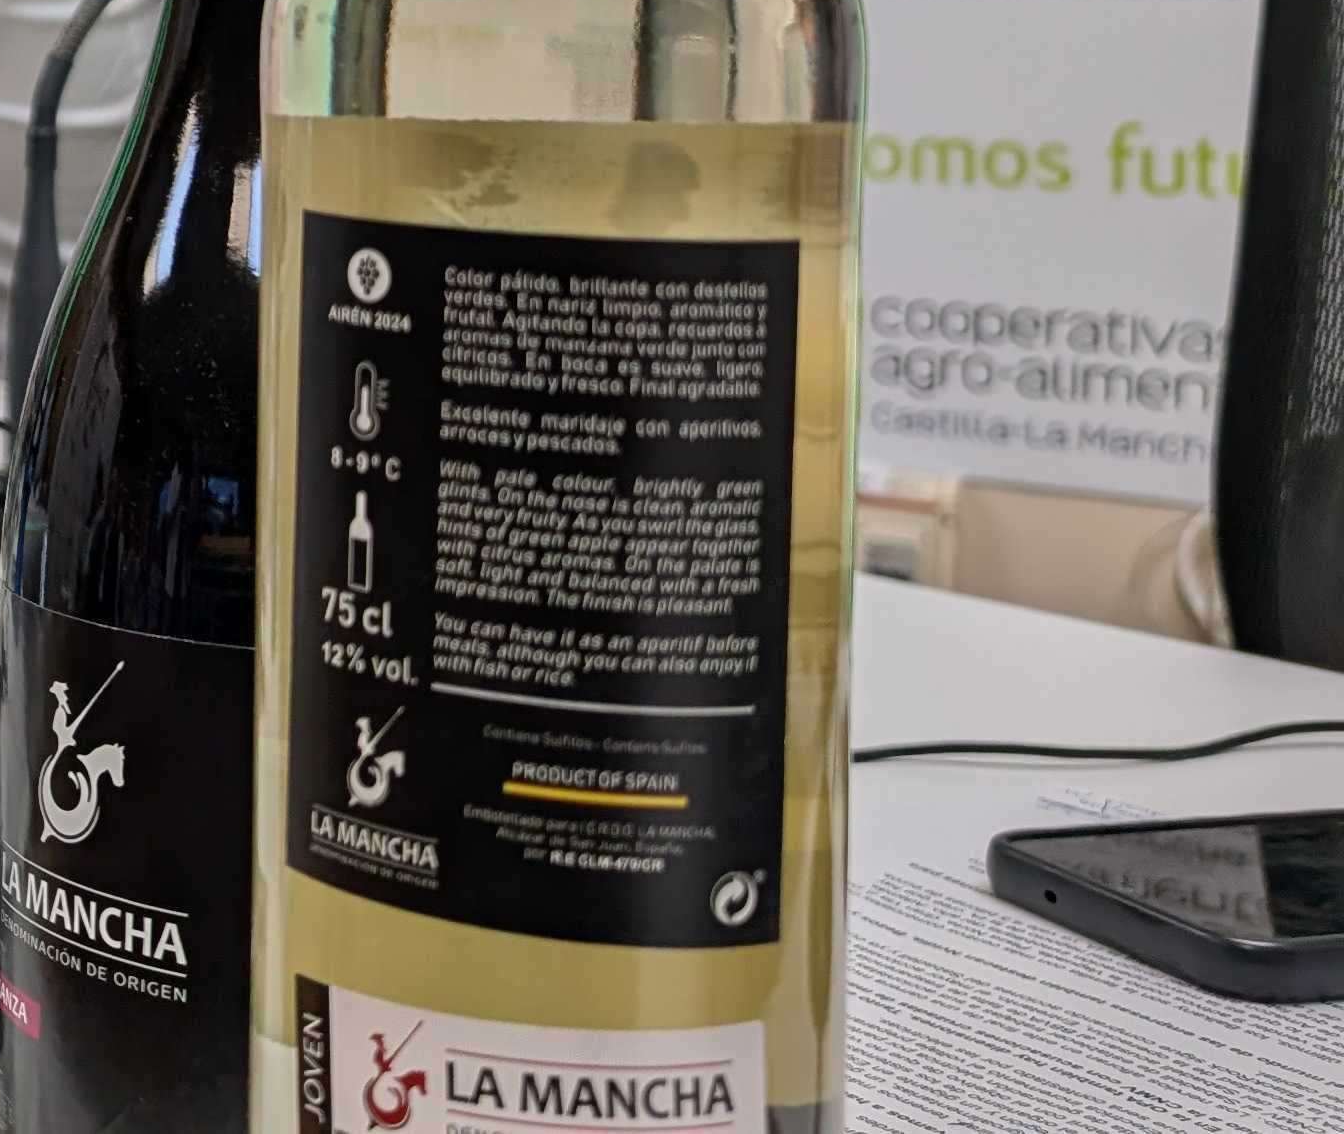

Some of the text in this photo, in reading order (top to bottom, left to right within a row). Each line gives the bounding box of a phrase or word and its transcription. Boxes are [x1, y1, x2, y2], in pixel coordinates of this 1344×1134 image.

[862, 130, 1073, 192] omos
[328, 302, 411, 333] AIRÉN 2024
[870, 344, 1220, 411] agro-alimen
[871, 400, 1211, 463] Castilla-La Manch
[321, 586, 393, 638] 75 cl
[322, 640, 419, 686] 12% vol.
[512, 760, 678, 791] PRODUCT OF SPAIN
[311, 810, 335, 839] LA
[337, 819, 440, 870] MANCHA
[1, 850, 188, 966] LA MANCHA
[0, 908, 187, 1003] DENOMINACIÓN DE ORIGEN
[302, 1012, 326, 1124] JOVEN
[445, 1061, 735, 1121] LA MANCHA
